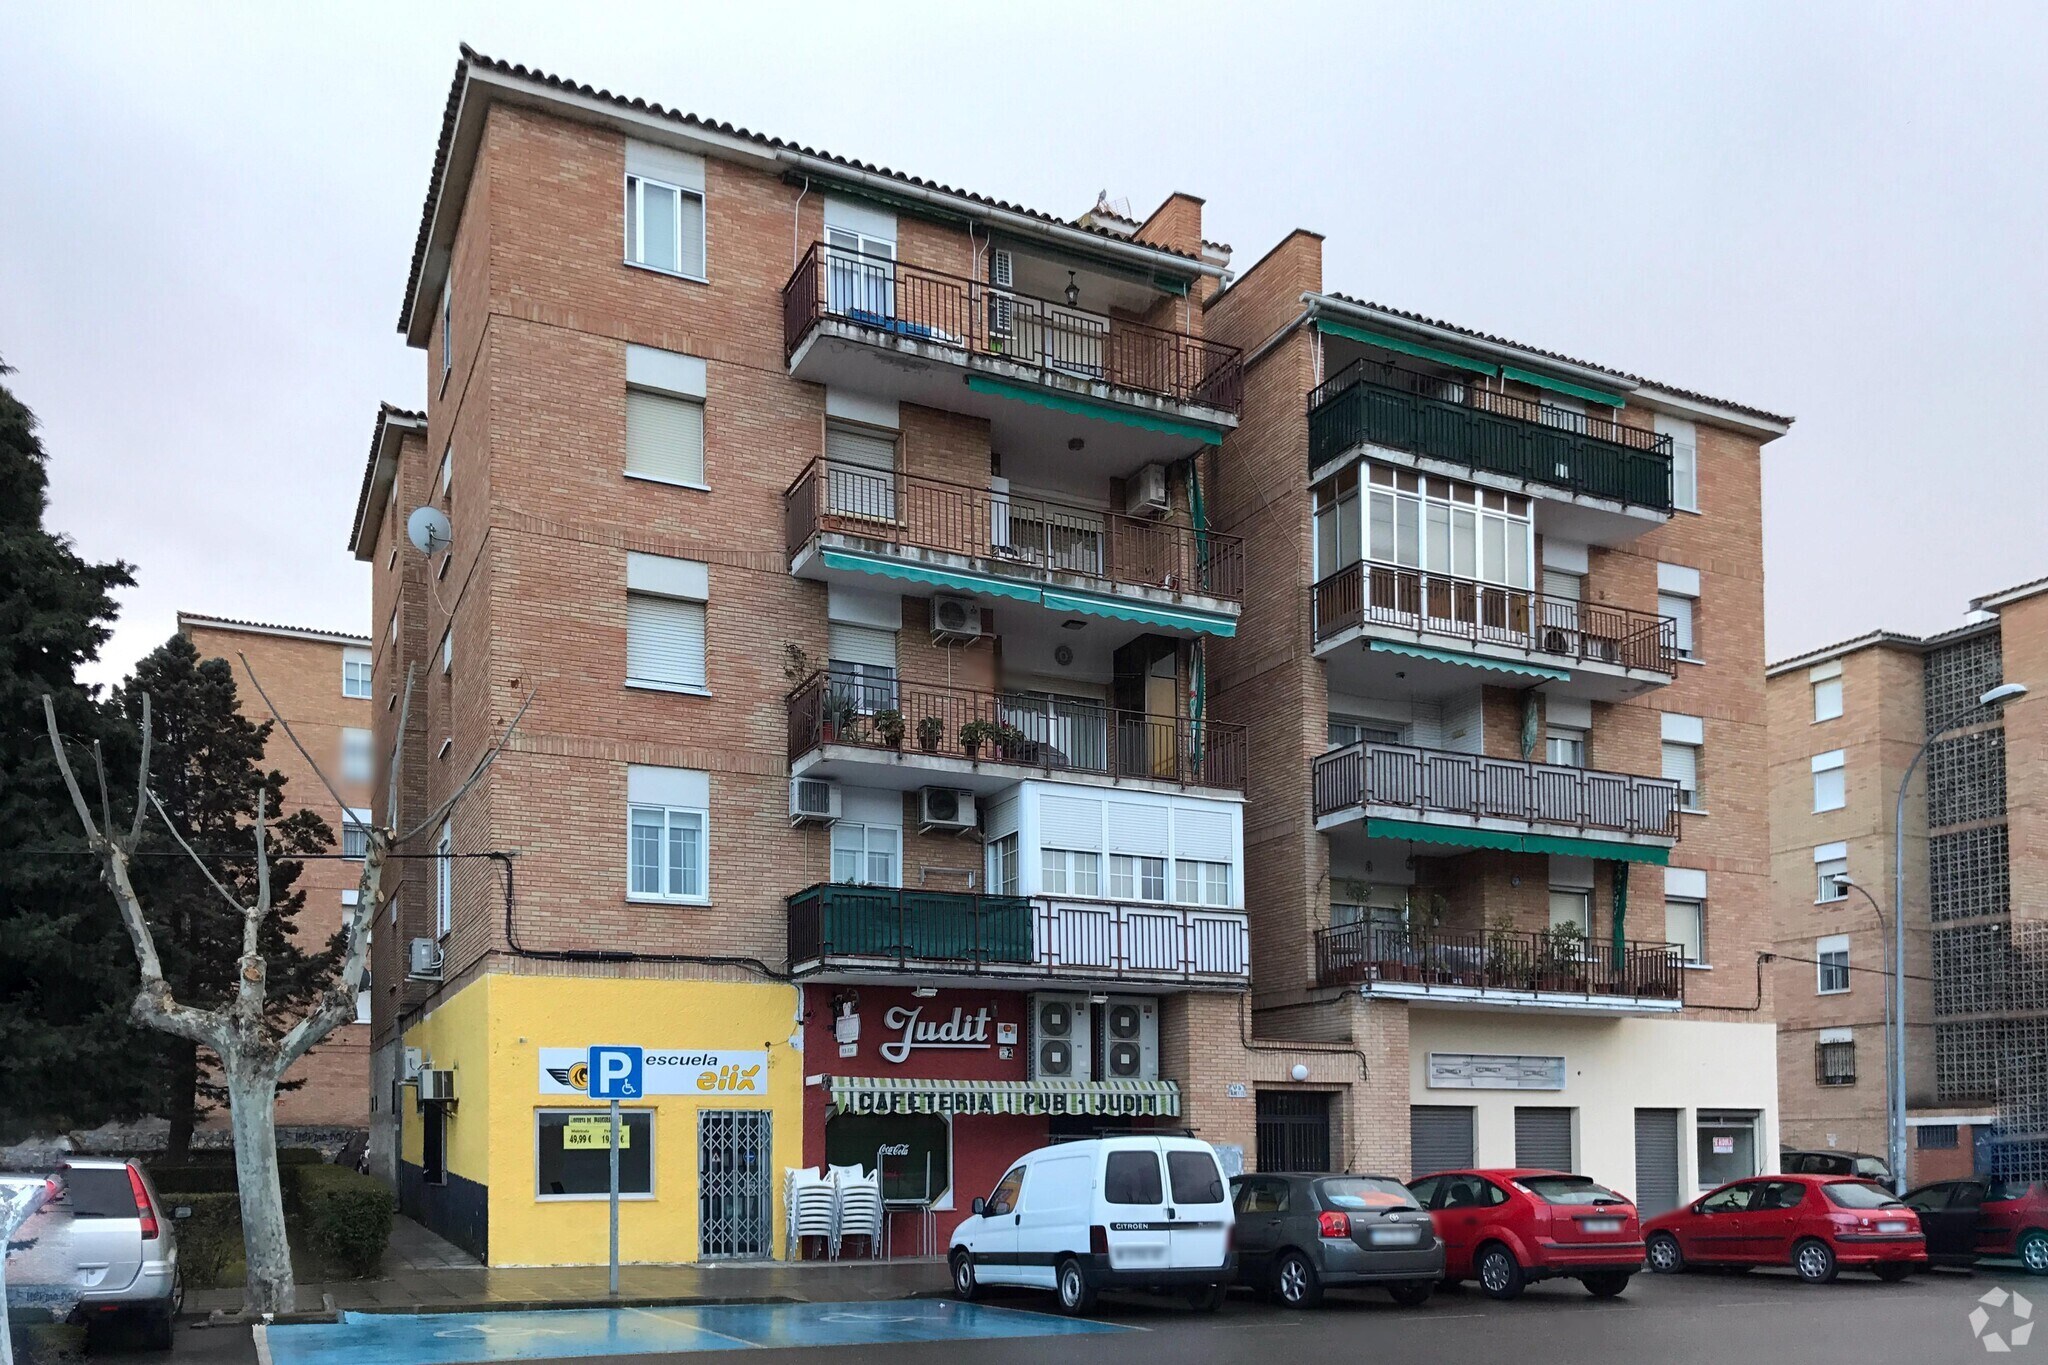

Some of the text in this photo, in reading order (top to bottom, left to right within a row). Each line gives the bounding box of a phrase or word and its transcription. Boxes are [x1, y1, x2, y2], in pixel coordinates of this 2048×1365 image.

[879, 1006, 992, 1063] Judit
[645, 1053, 718, 1066] escuela
[600, 1051, 632, 1093] P
[859, 1092, 1155, 1112] CAFETERIA PUB JUDIT
[569, 1134, 587, 1144] 49,99
[1115, 1222, 1149, 1230] CITROËN
